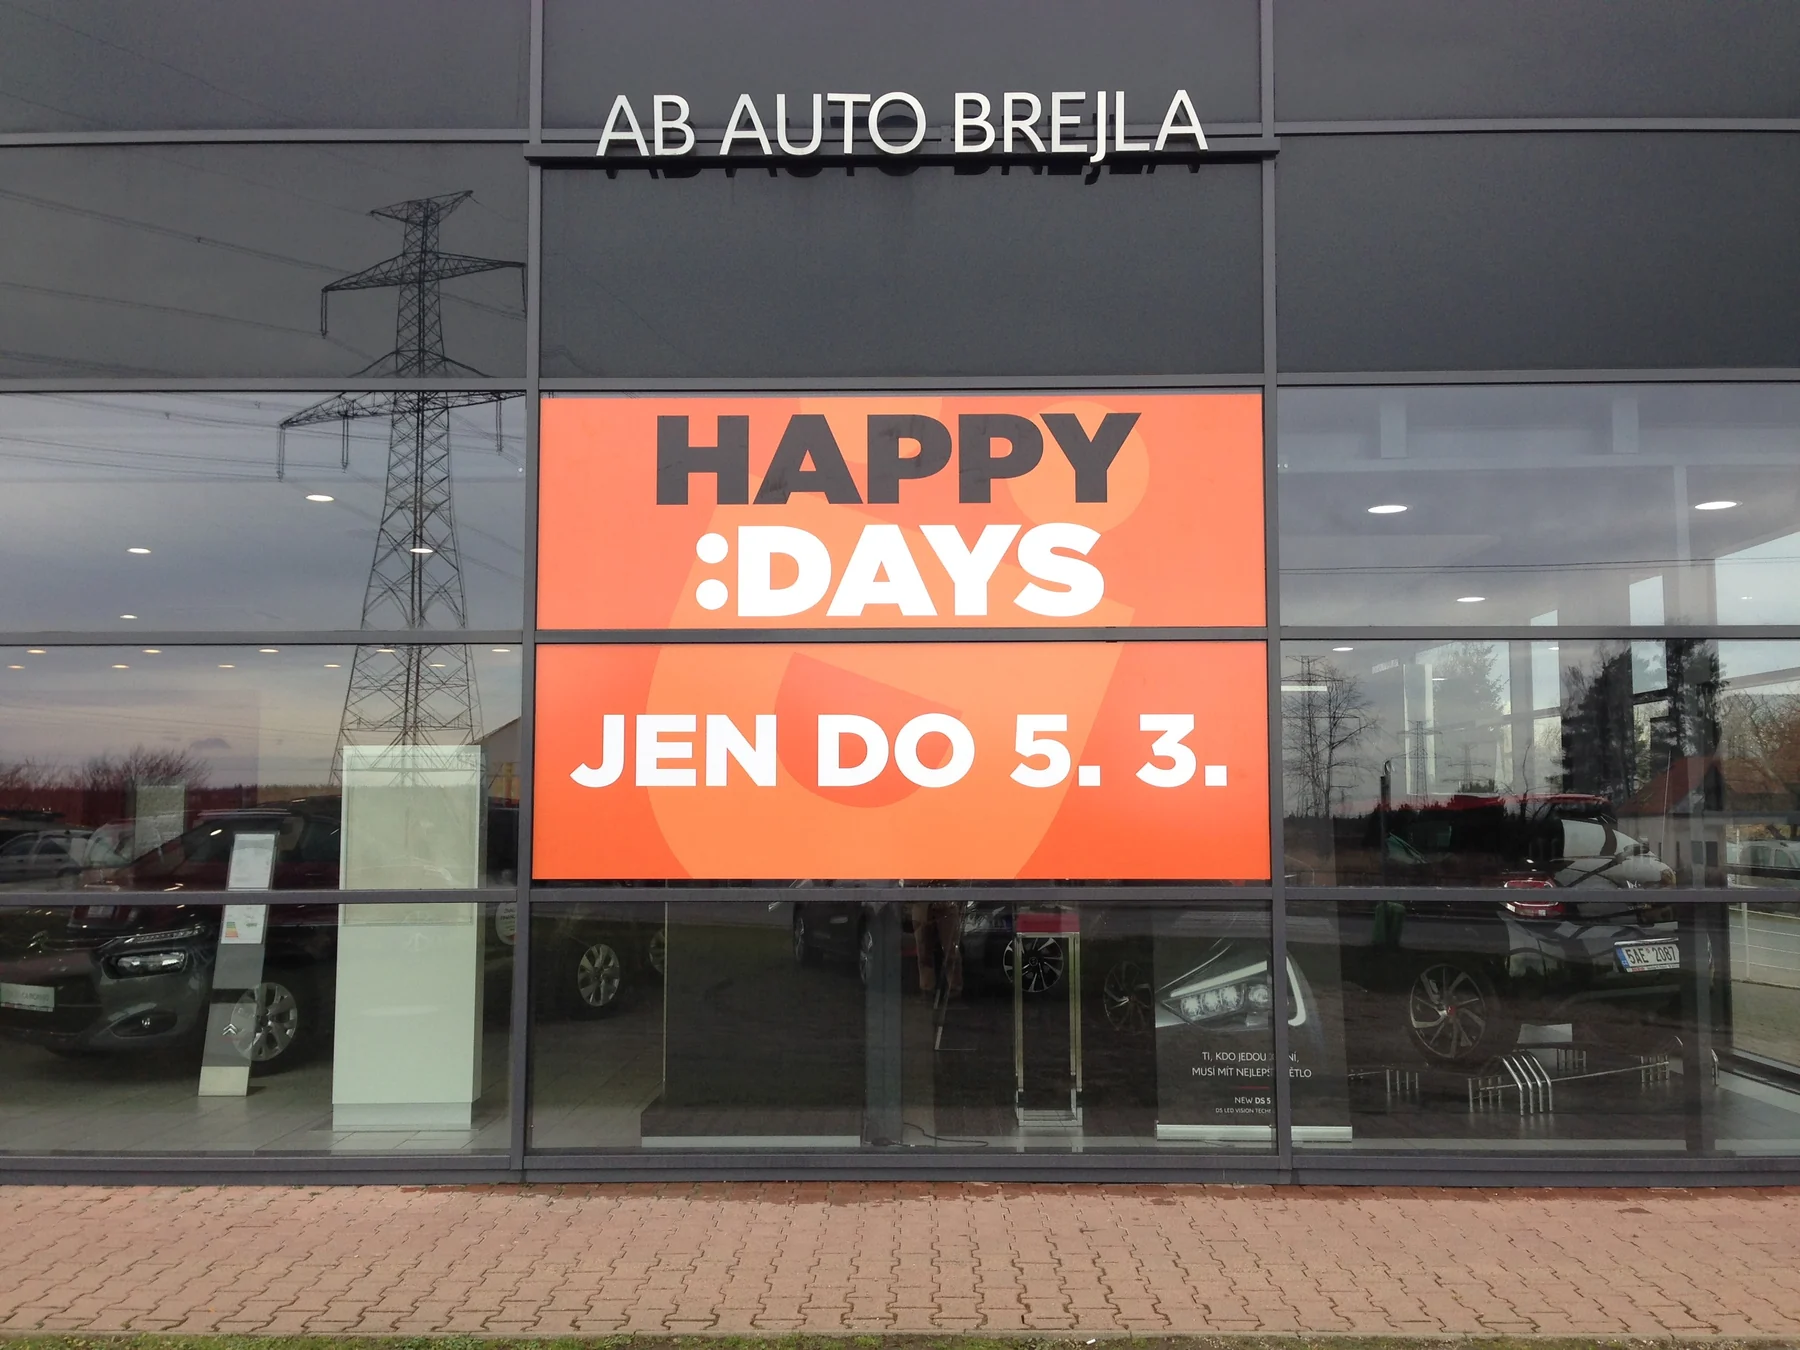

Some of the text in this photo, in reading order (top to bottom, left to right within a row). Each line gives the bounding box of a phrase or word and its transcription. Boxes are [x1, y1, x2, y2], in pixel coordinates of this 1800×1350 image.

[596, 90, 1209, 163] AB AUTO BREJLA
[656, 413, 1141, 505] HAPPY
[570, 713, 1227, 788] JEN DO 5. 3.
[1625, 948, 1649, 964] 5AE
[1652, 946, 1677, 962] 2087
[1202, 1051, 1213, 1062] TI,
[1215, 1051, 1236, 1061] KDO
[1238, 1052, 1267, 1062] JEDOU
[1192, 1065, 1216, 1077] MUSÍ
[1217, 1065, 1234, 1077] MÍT
[1289, 1066, 1312, 1078] ĚTLO
[1234, 1096, 1272, 1105] NEW DS 5
